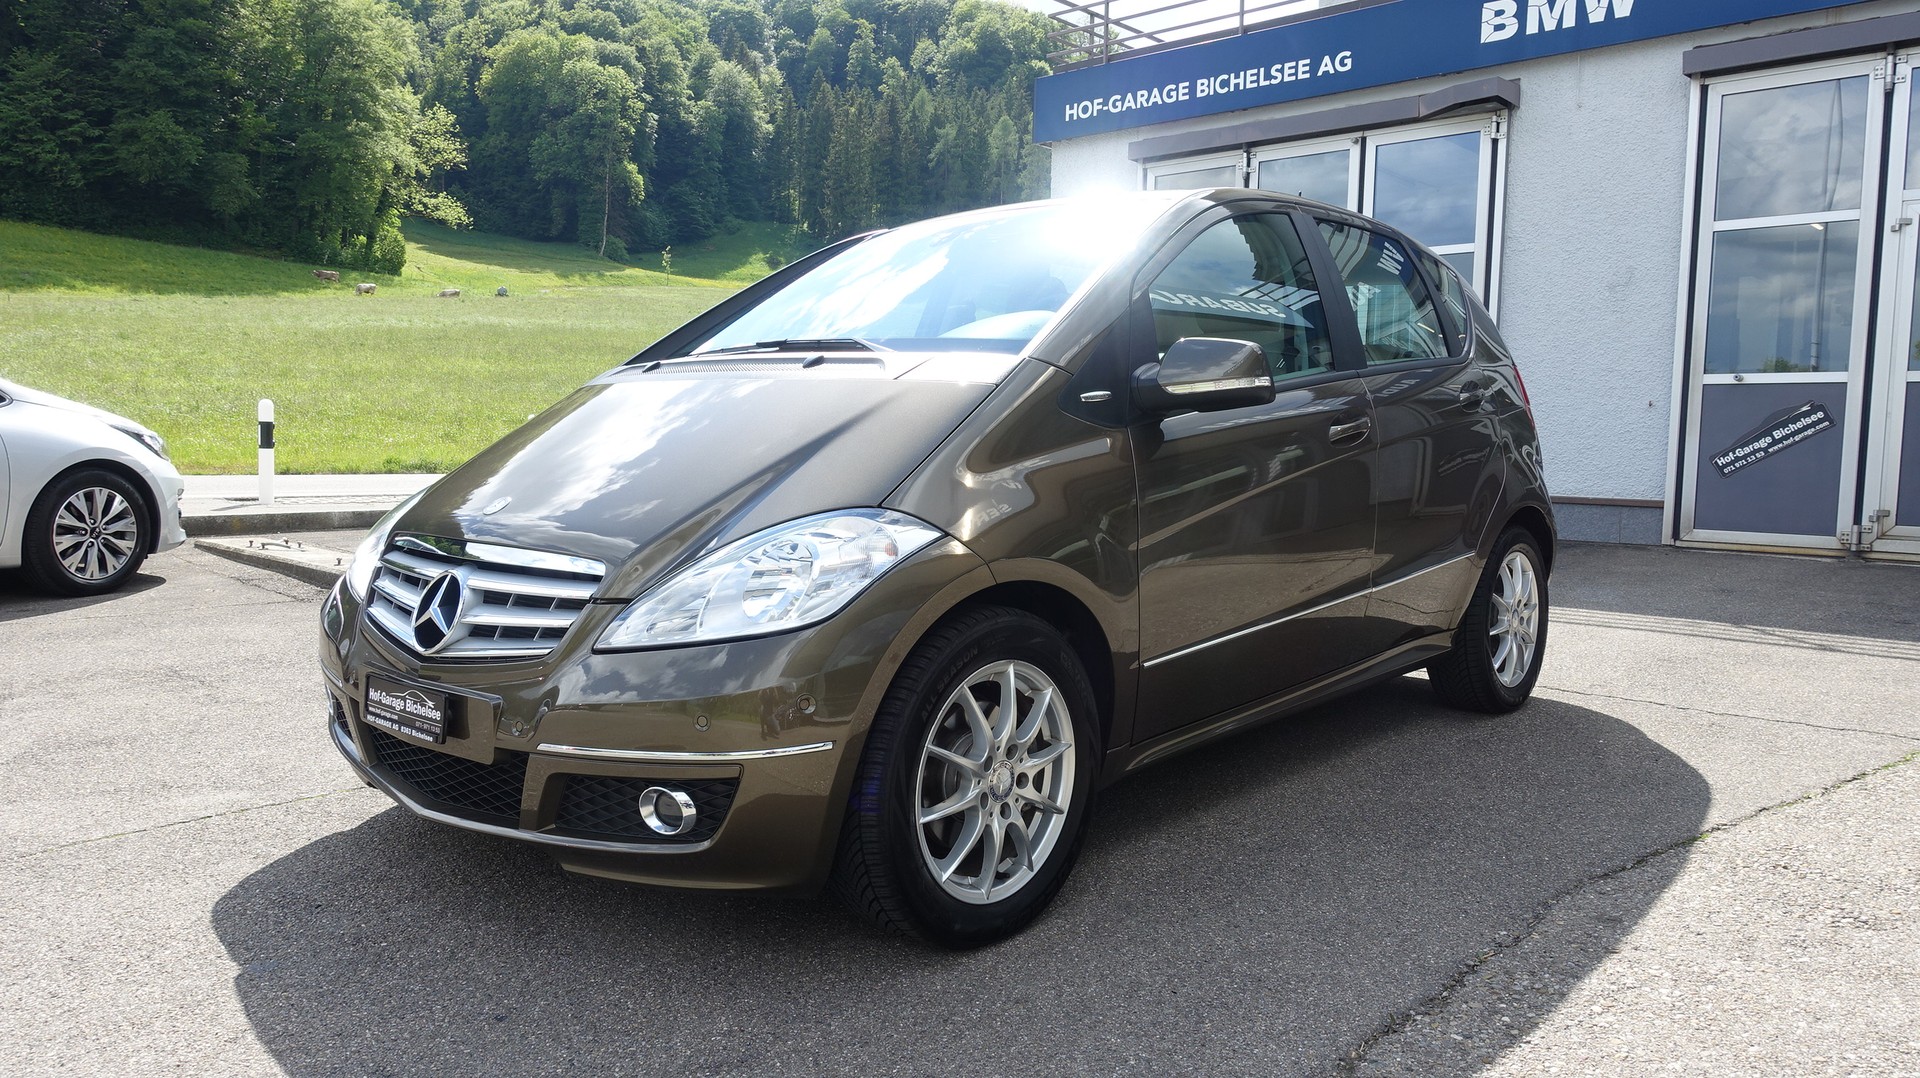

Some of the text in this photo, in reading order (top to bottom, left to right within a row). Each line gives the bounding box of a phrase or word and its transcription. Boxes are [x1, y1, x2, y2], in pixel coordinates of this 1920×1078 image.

[1480, 0, 1635, 44] BMW
[1065, 50, 1353, 122] HOF-GARAGE BICHELSEE AG
[1716, 411, 1825, 467] Hof-Garage Bichelsee
[1767, 421, 1830, 453] www.hof-garage.com
[369, 687, 441, 721] Hof-Garage Bichelsee
[366, 714, 392, 729] HOF-GARAGE
[392, 722, 399, 731] AG
[411, 729, 434, 742] Bichelsee
